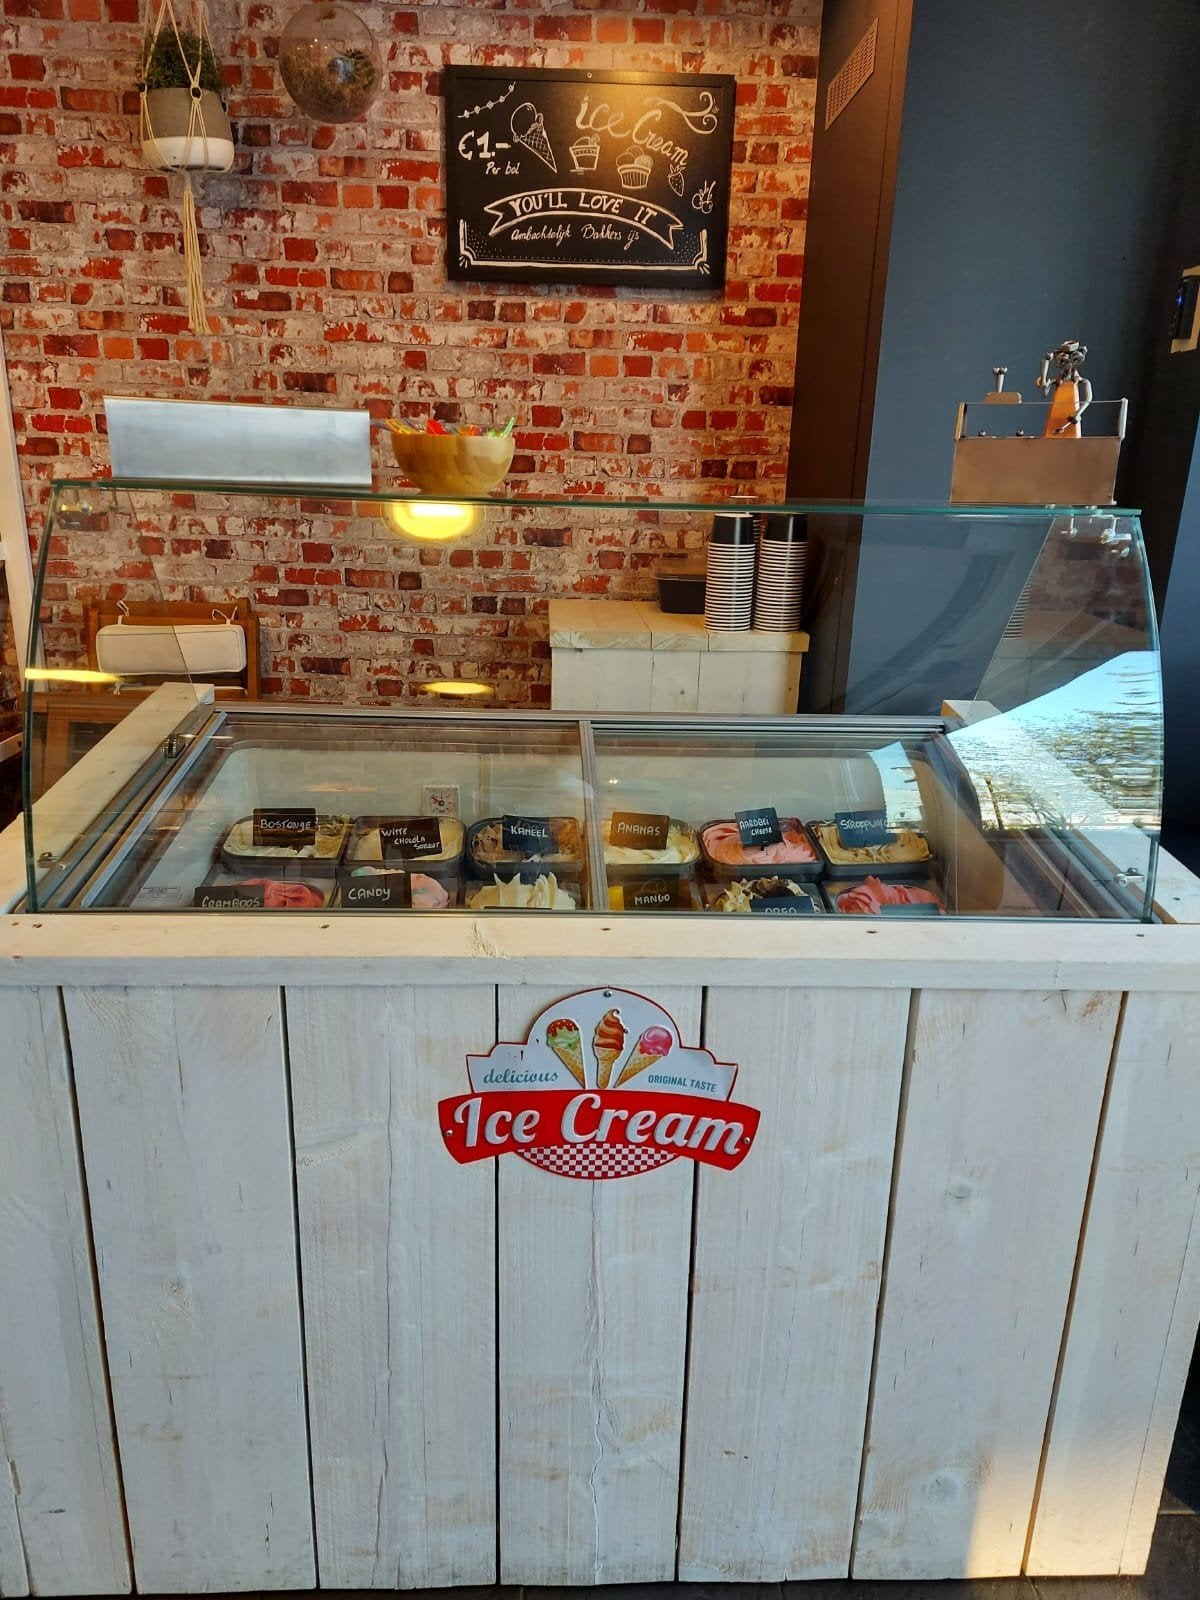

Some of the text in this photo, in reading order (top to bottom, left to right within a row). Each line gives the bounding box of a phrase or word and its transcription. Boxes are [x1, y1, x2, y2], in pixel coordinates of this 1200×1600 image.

[632, 108, 689, 166] Cream
[485, 160, 521, 175] Per bol
[508, 191, 658, 226] YOU'LL LOVE IT
[623, 229, 641, 250] ijs
[510, 825, 548, 838] KANEEL
[617, 821, 661, 836] ANANAS
[348, 887, 391, 902] CANDY
[634, 893, 671, 906] MANGO
[482, 1067, 559, 1085] delicious
[647, 1074, 717, 1094] ORIGINAL TASTE
[453, 1093, 746, 1156] Ice Cream
